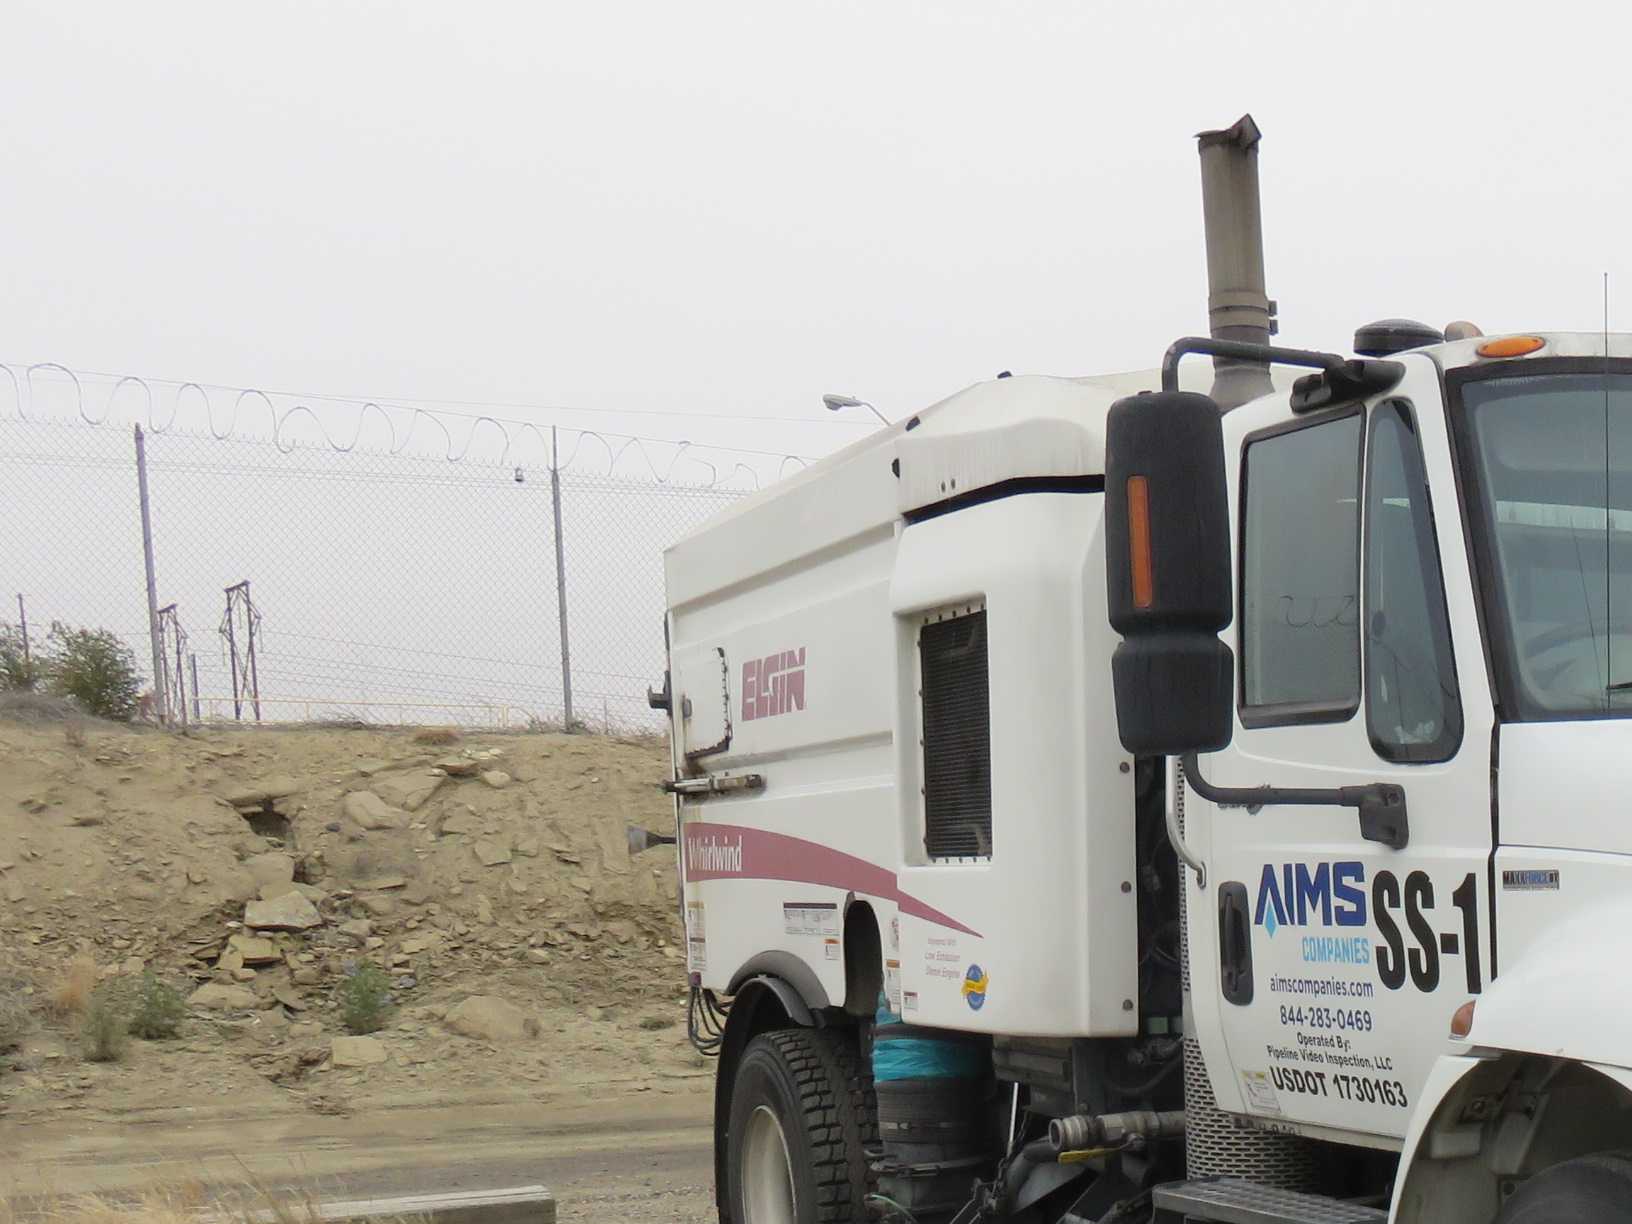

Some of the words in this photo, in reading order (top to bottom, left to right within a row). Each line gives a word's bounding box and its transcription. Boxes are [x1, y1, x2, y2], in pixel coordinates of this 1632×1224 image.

[742, 647, 805, 721] ELGIN
[688, 835, 743, 872] Whirlwind
[1254, 861, 1367, 927] AIMS
[1372, 870, 1482, 994] SS-1
[1302, 937, 1370, 964] COMPANIES
[1270, 974, 1374, 998] aimscompanies.com
[1280, 1005, 1372, 1032] 844-283-0469
[1267, 1045, 1299, 1061] Pipeline
[1300, 1049, 1324, 1064] Video
[1325, 1052, 1374, 1071] Inspection,
[1375, 1056, 1393, 1070] LLC
[1297, 1032, 1335, 1048] Operated
[1336, 1036, 1351, 1052] By:
[1270, 1065, 1328, 1096] USDOT
[1333, 1074, 1408, 1107] 1730163
